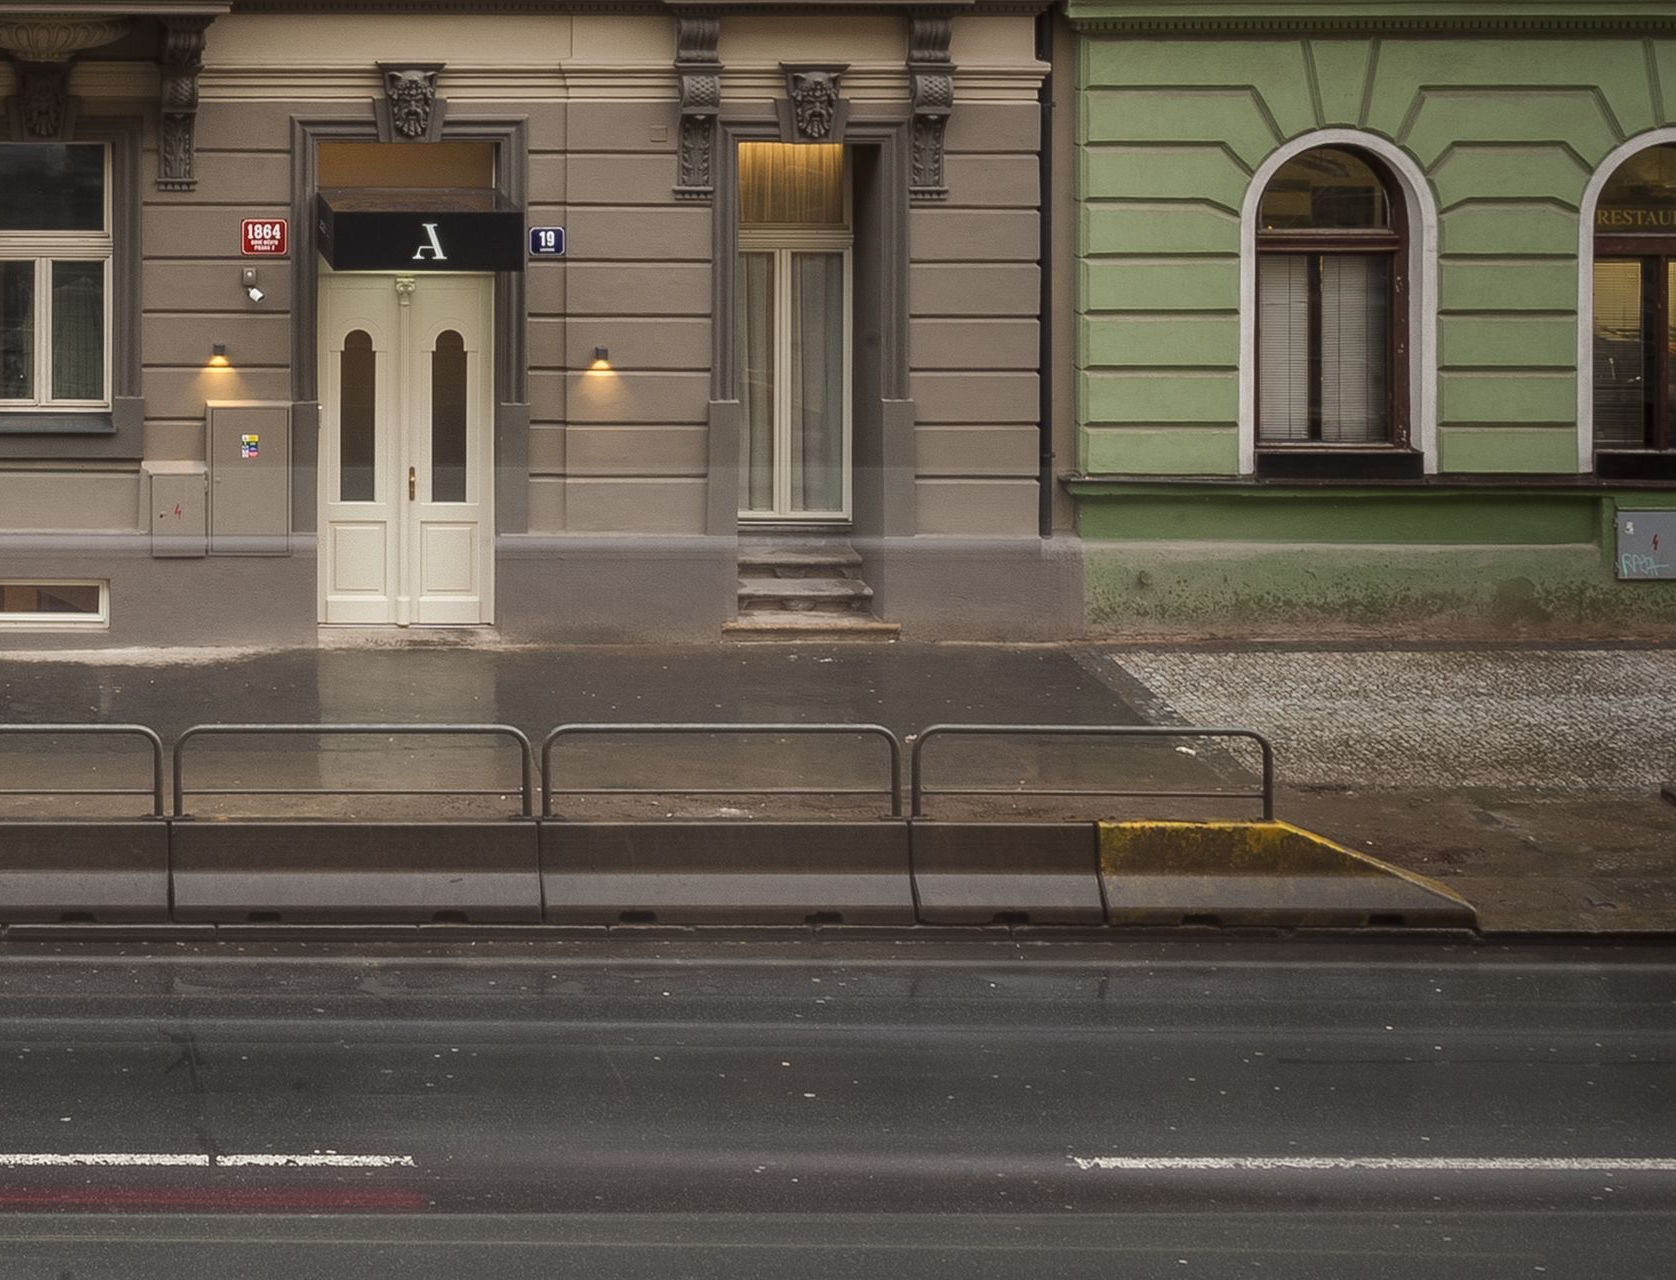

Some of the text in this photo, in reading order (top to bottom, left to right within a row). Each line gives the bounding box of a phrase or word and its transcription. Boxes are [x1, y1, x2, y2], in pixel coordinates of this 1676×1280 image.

[1596, 209, 1676, 225] RESTAU
[247, 223, 281, 240] 1864
[539, 230, 555, 247] 19
[412, 223, 448, 260] A
